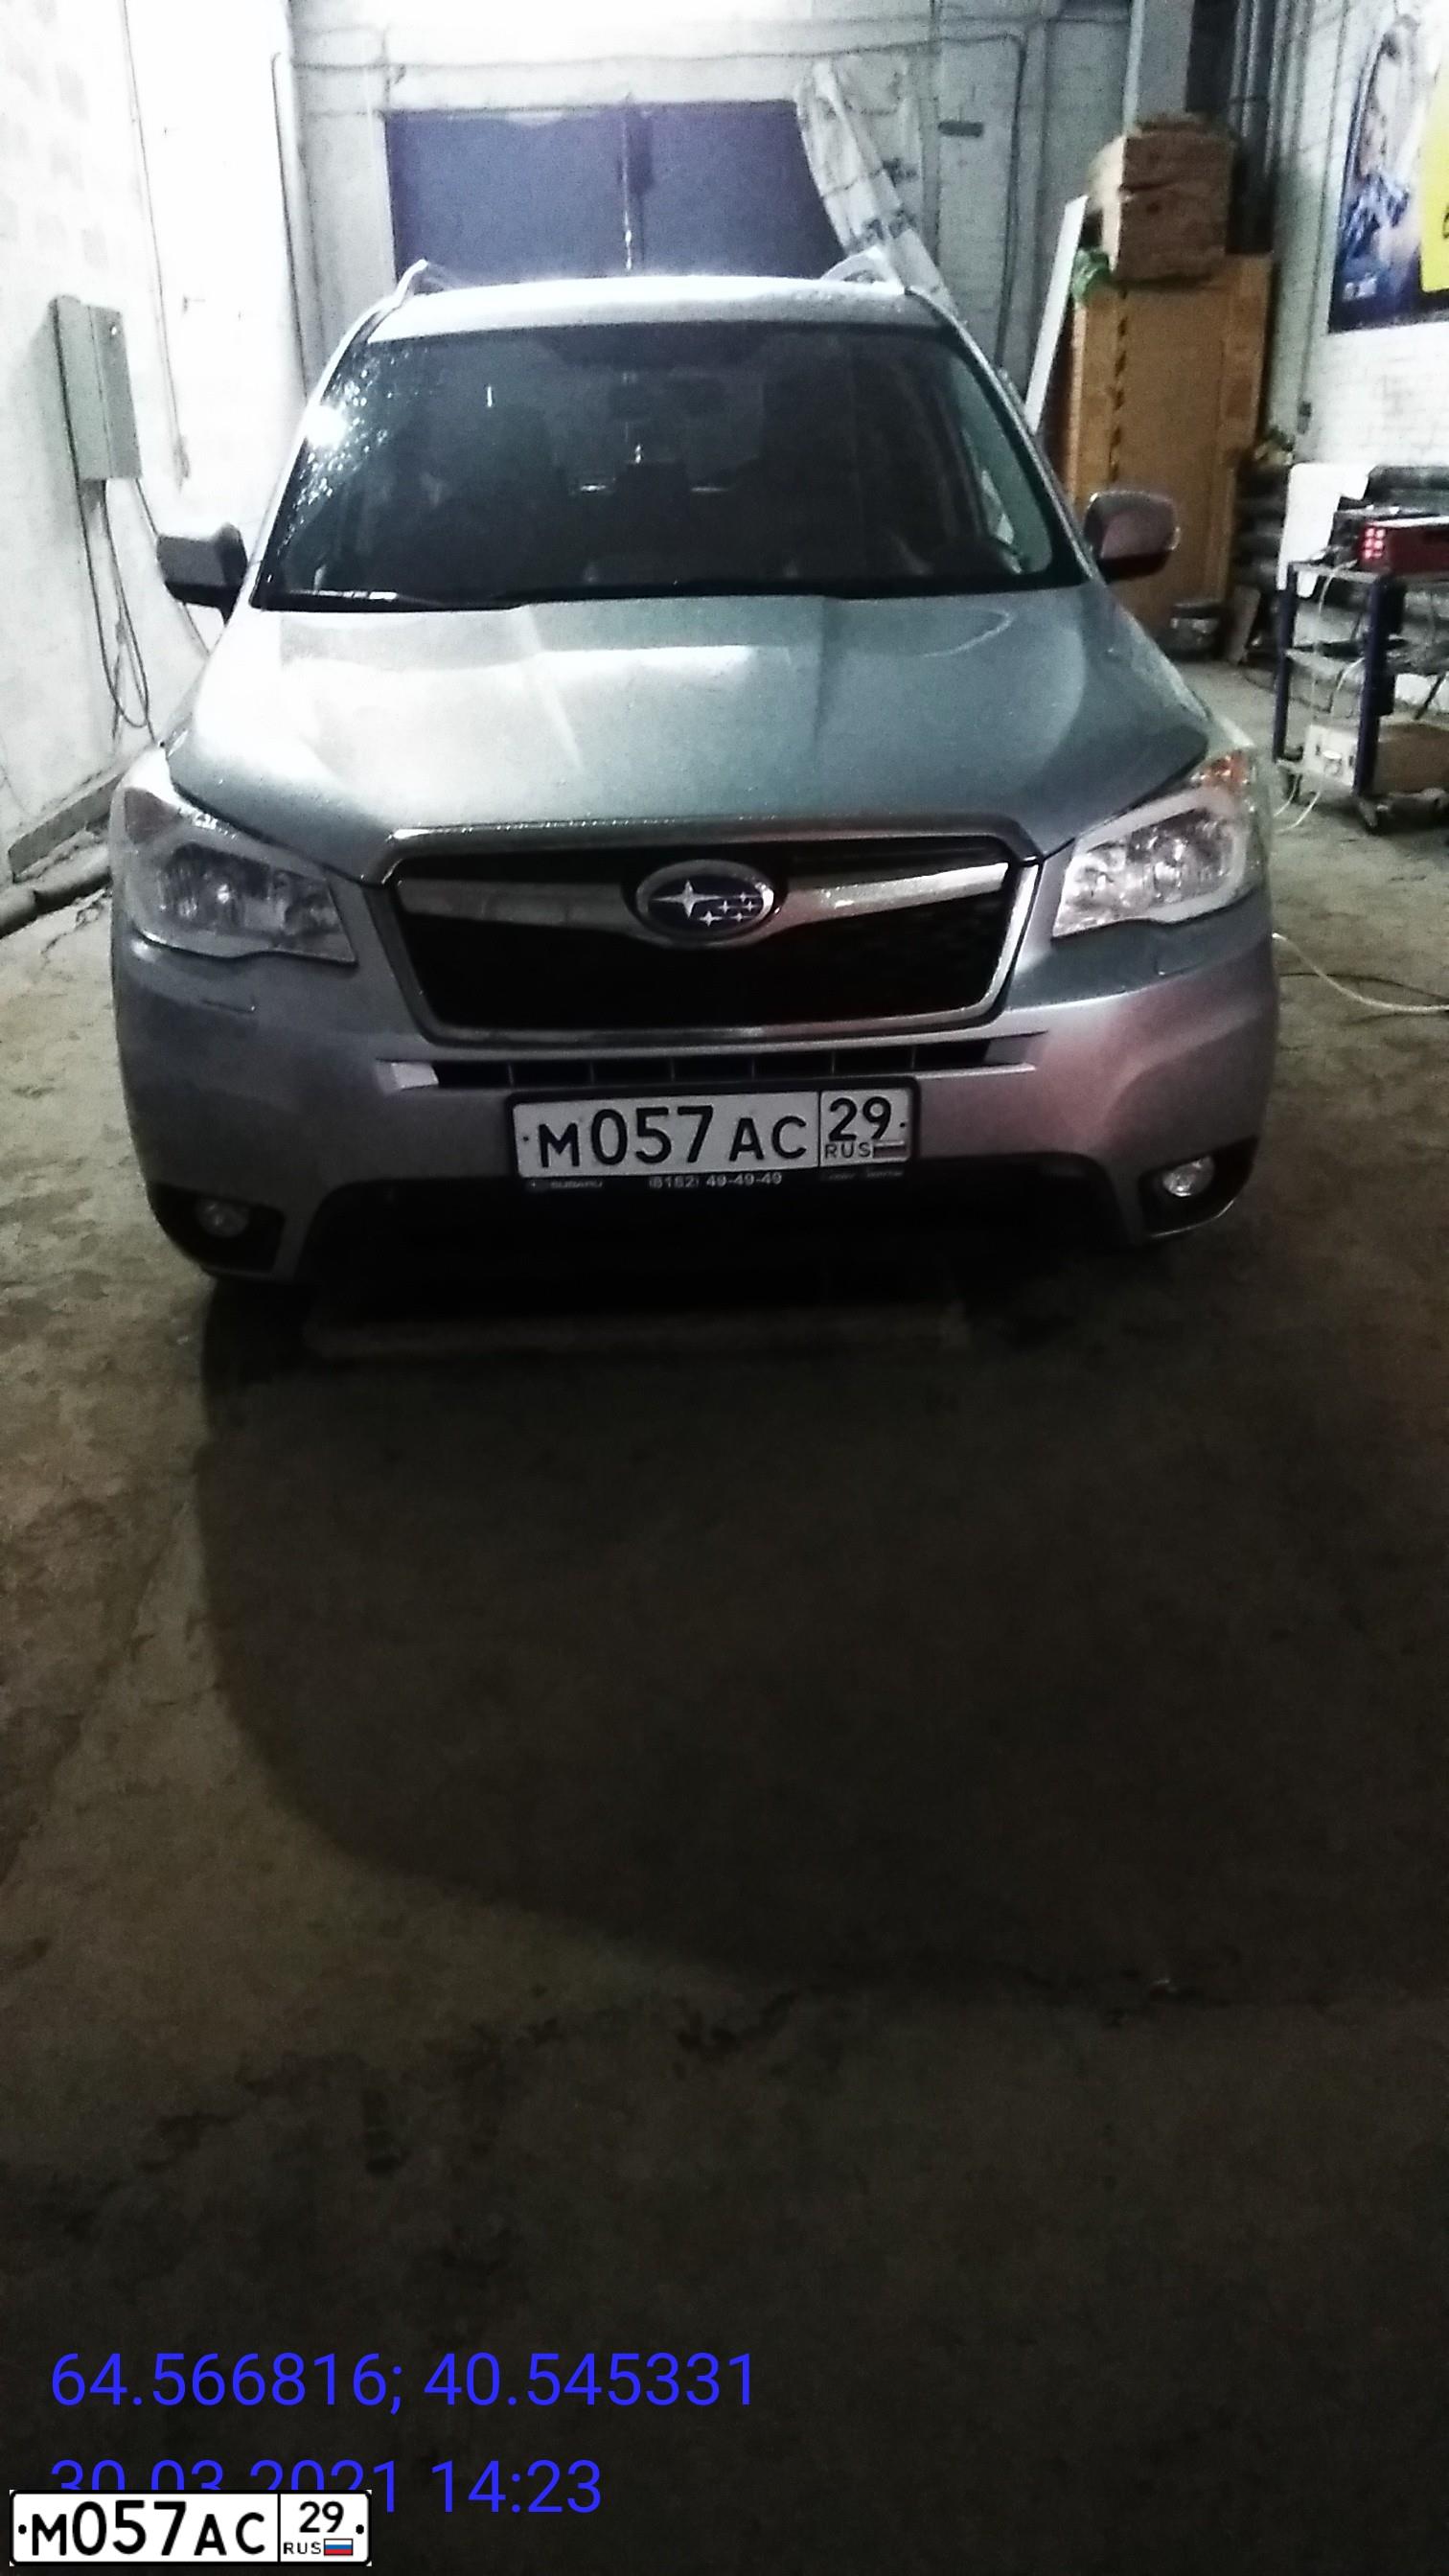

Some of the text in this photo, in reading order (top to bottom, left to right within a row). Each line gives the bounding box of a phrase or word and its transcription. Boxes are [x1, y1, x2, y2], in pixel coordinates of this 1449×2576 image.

[828, 1096, 892, 1142] 29
[824, 1141, 871, 1160] RUS
[704, 1171, 783, 1187] 49-49-49
